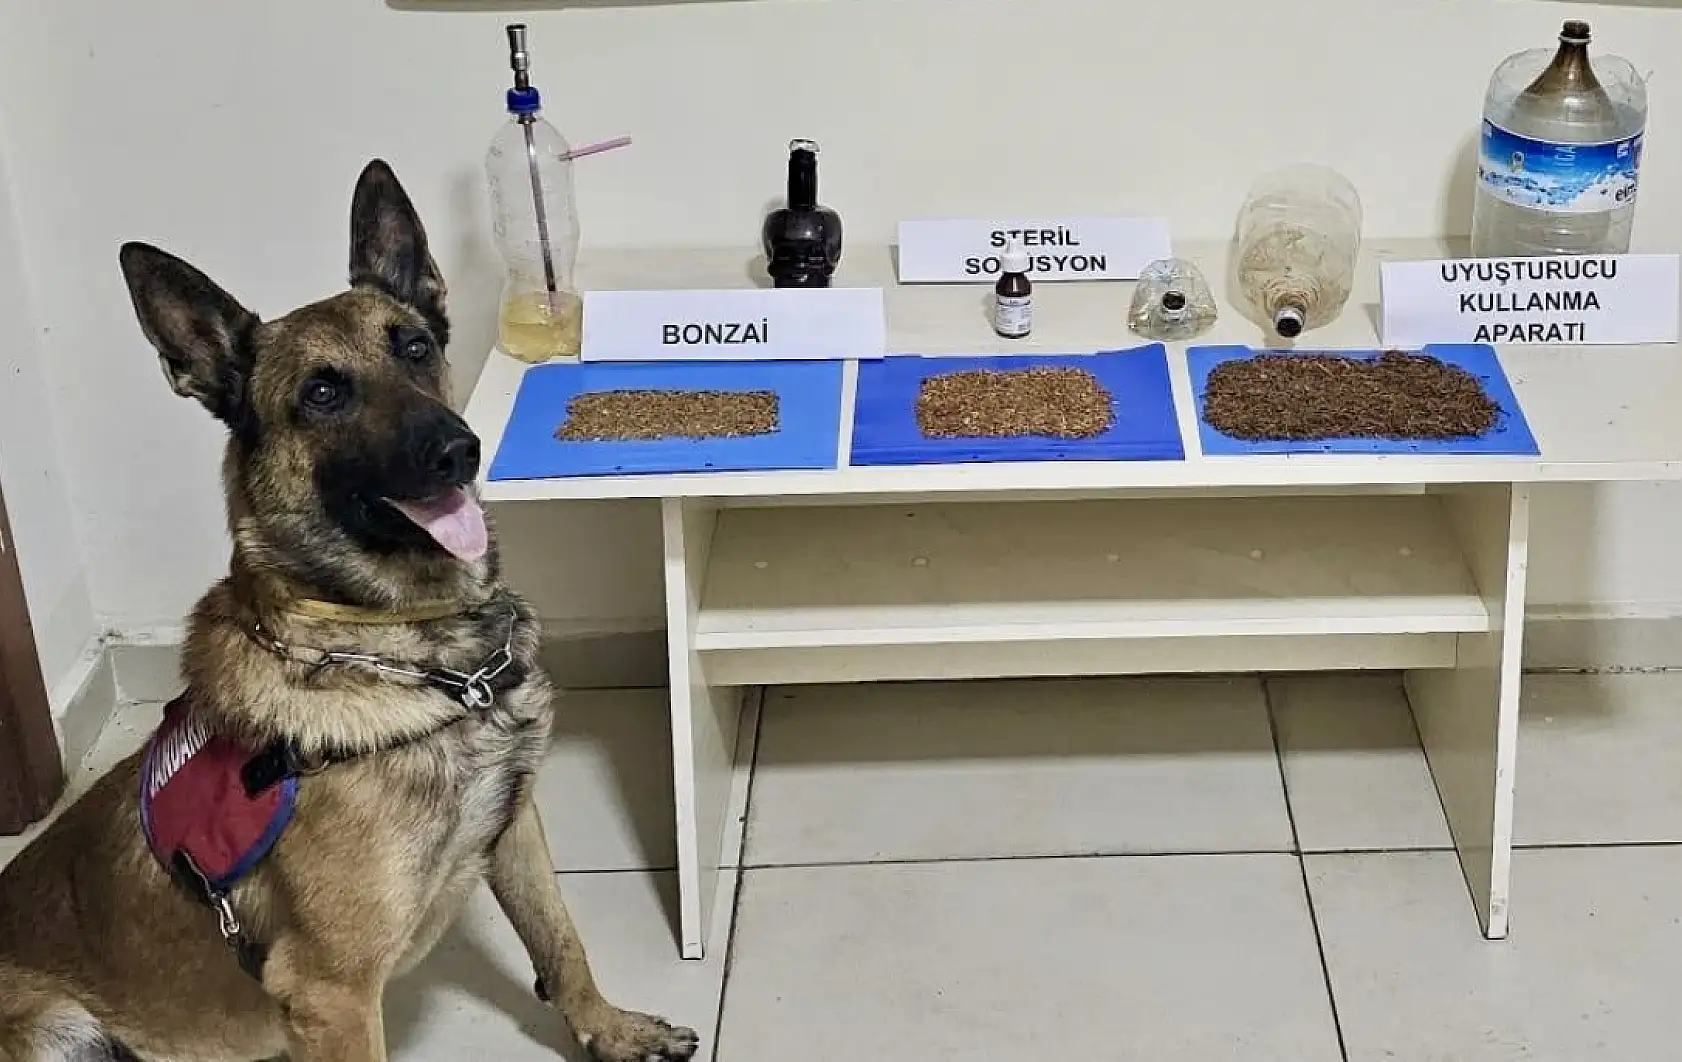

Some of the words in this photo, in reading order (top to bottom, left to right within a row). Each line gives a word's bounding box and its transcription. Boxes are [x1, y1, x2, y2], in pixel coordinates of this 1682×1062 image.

[965, 255, 1106, 275] SOSYON
[1441, 259, 1617, 286] UYUŞTURUCU
[1460, 290, 1600, 313] KULLANMA
[662, 318, 768, 345] BONZAİ
[1473, 322, 1585, 343] APARATI
